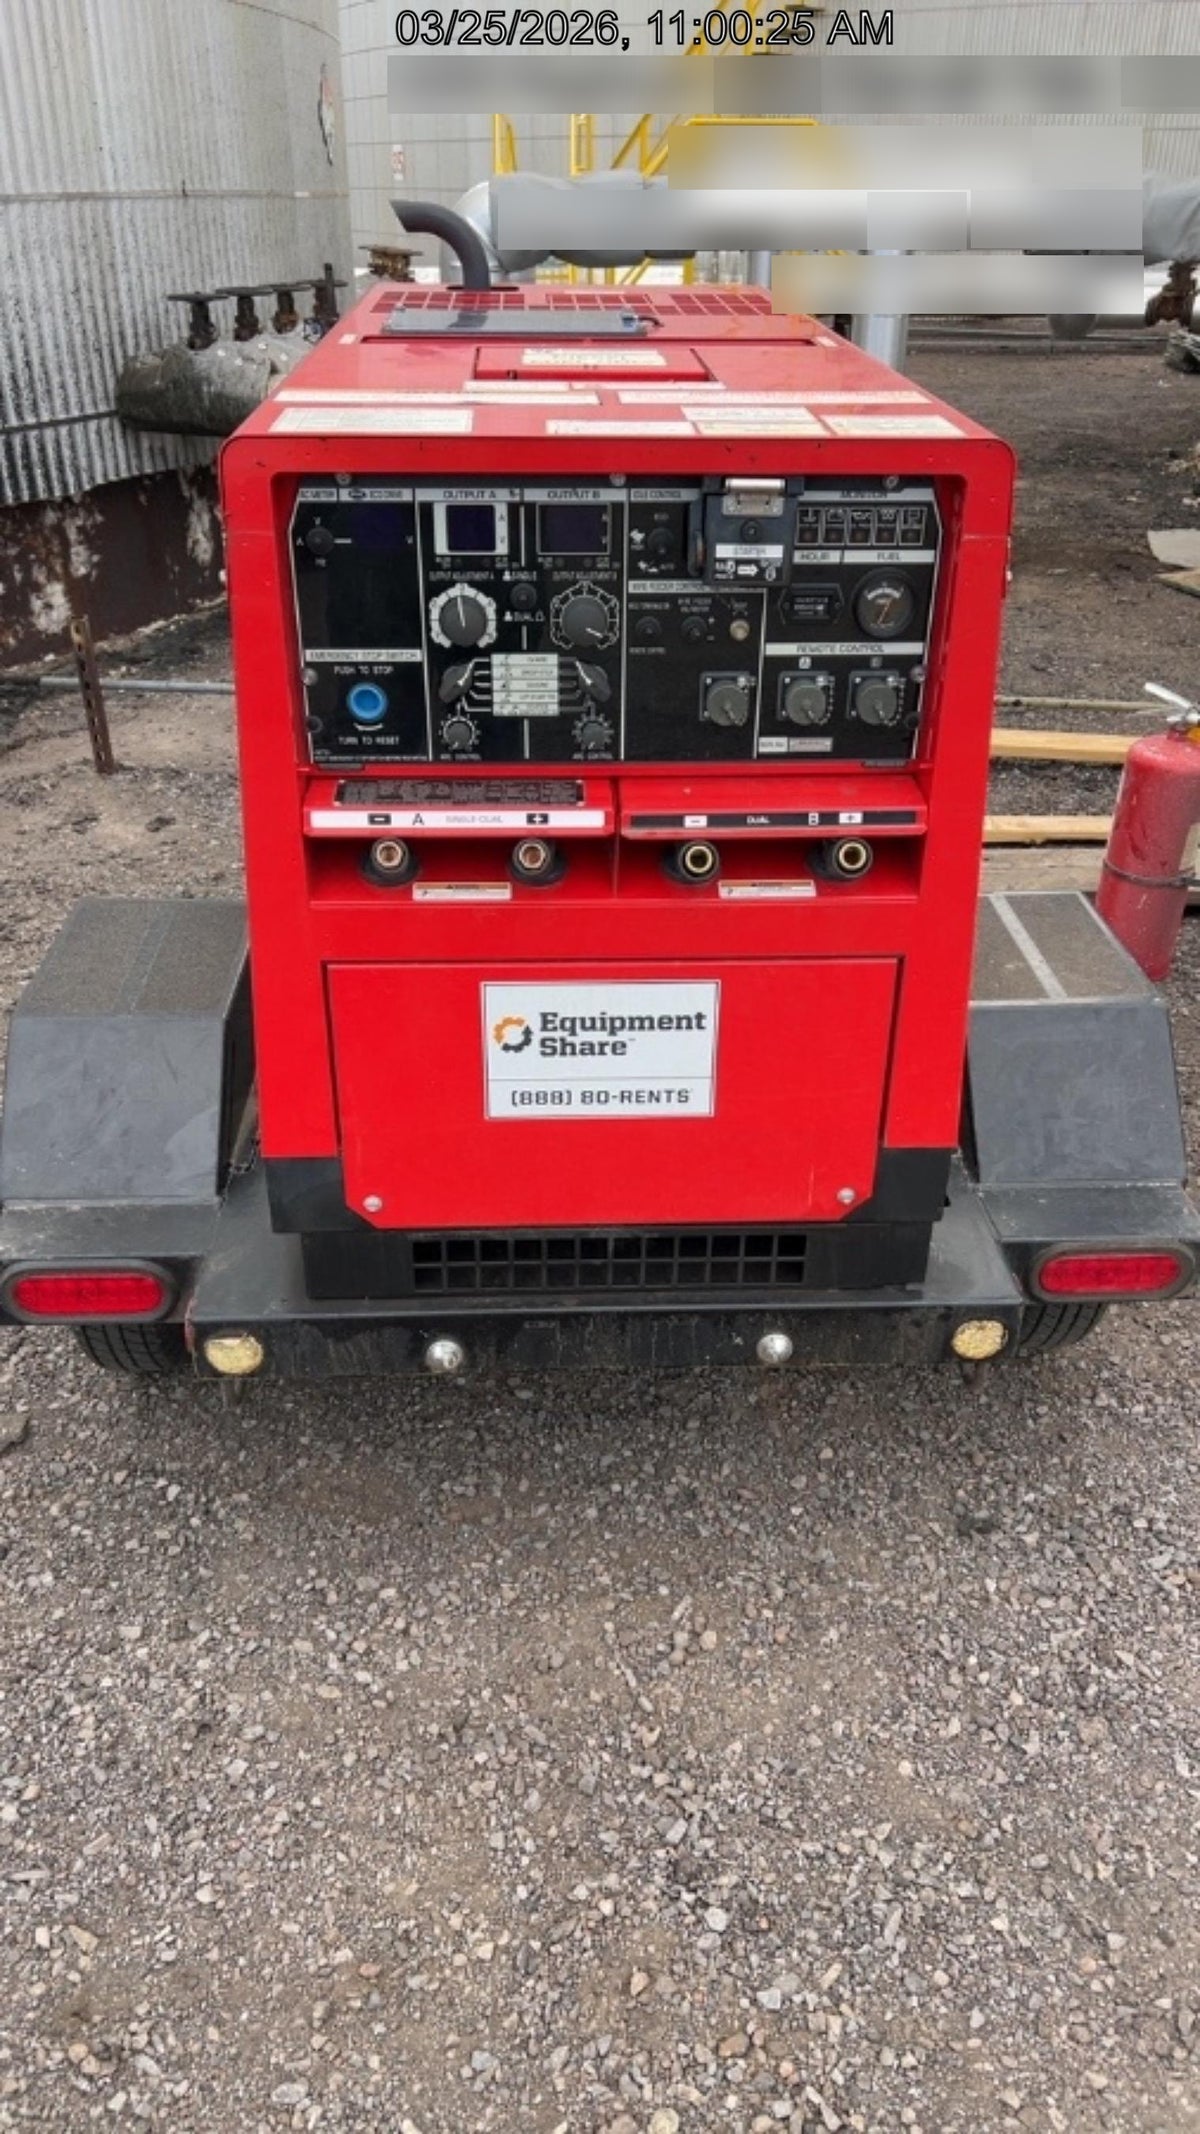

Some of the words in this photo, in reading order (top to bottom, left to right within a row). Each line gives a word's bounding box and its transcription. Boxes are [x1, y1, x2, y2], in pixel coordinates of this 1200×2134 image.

[443, 490, 483, 499] OUTPUT
[488, 490, 496, 499] A
[547, 490, 592, 499] OUTPUT
[877, 552, 900, 561] FUEL
[838, 644, 885, 653] CONTROL
[333, 665, 356, 675] PUSH
[358, 665, 370, 675] TO
[372, 665, 394, 675] STOP
[362, 736, 373, 746] TO
[376, 736, 400, 746] RESET
[412, 813, 424, 825] A
[747, 815, 770, 824] DUAL
[809, 813, 819, 825] B
[539, 1011, 708, 1037] Equipment
[539, 1037, 628, 1057] Share
[511, 1089, 573, 1107] (888)
[580, 1088, 691, 1106] 80-RENTS
